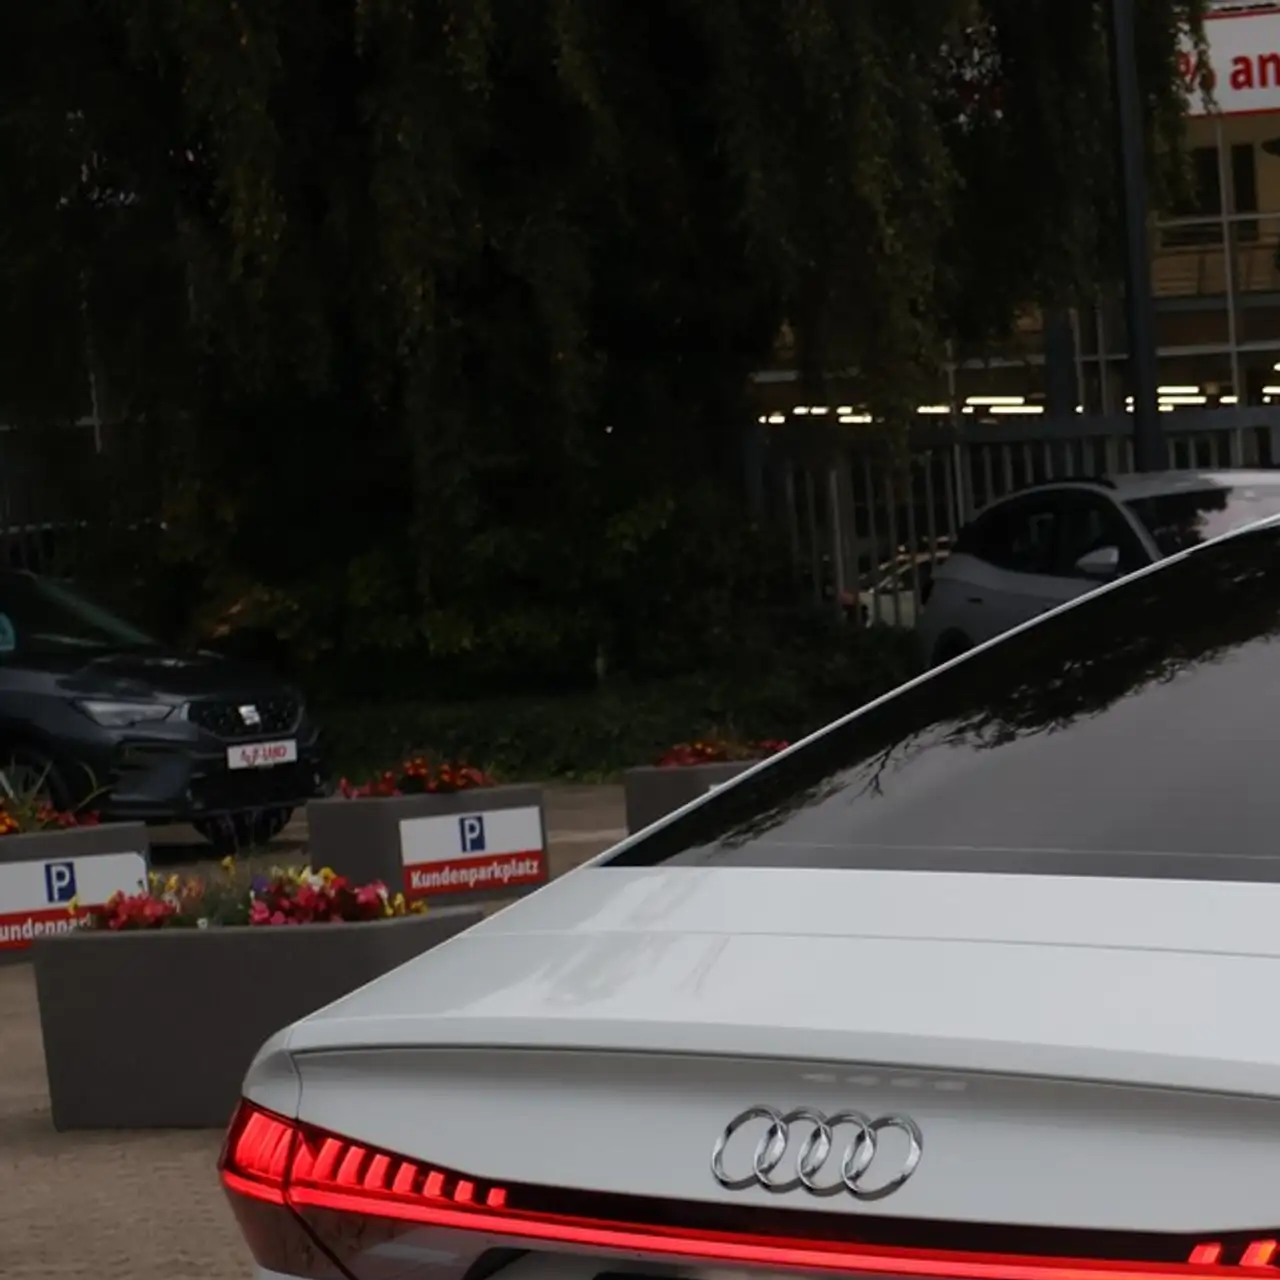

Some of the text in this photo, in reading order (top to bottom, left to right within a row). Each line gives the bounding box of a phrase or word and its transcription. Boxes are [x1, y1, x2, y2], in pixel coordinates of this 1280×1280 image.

[463, 817, 482, 852] P
[51, 863, 71, 901] P
[409, 857, 541, 890] Kundenparkplatz
